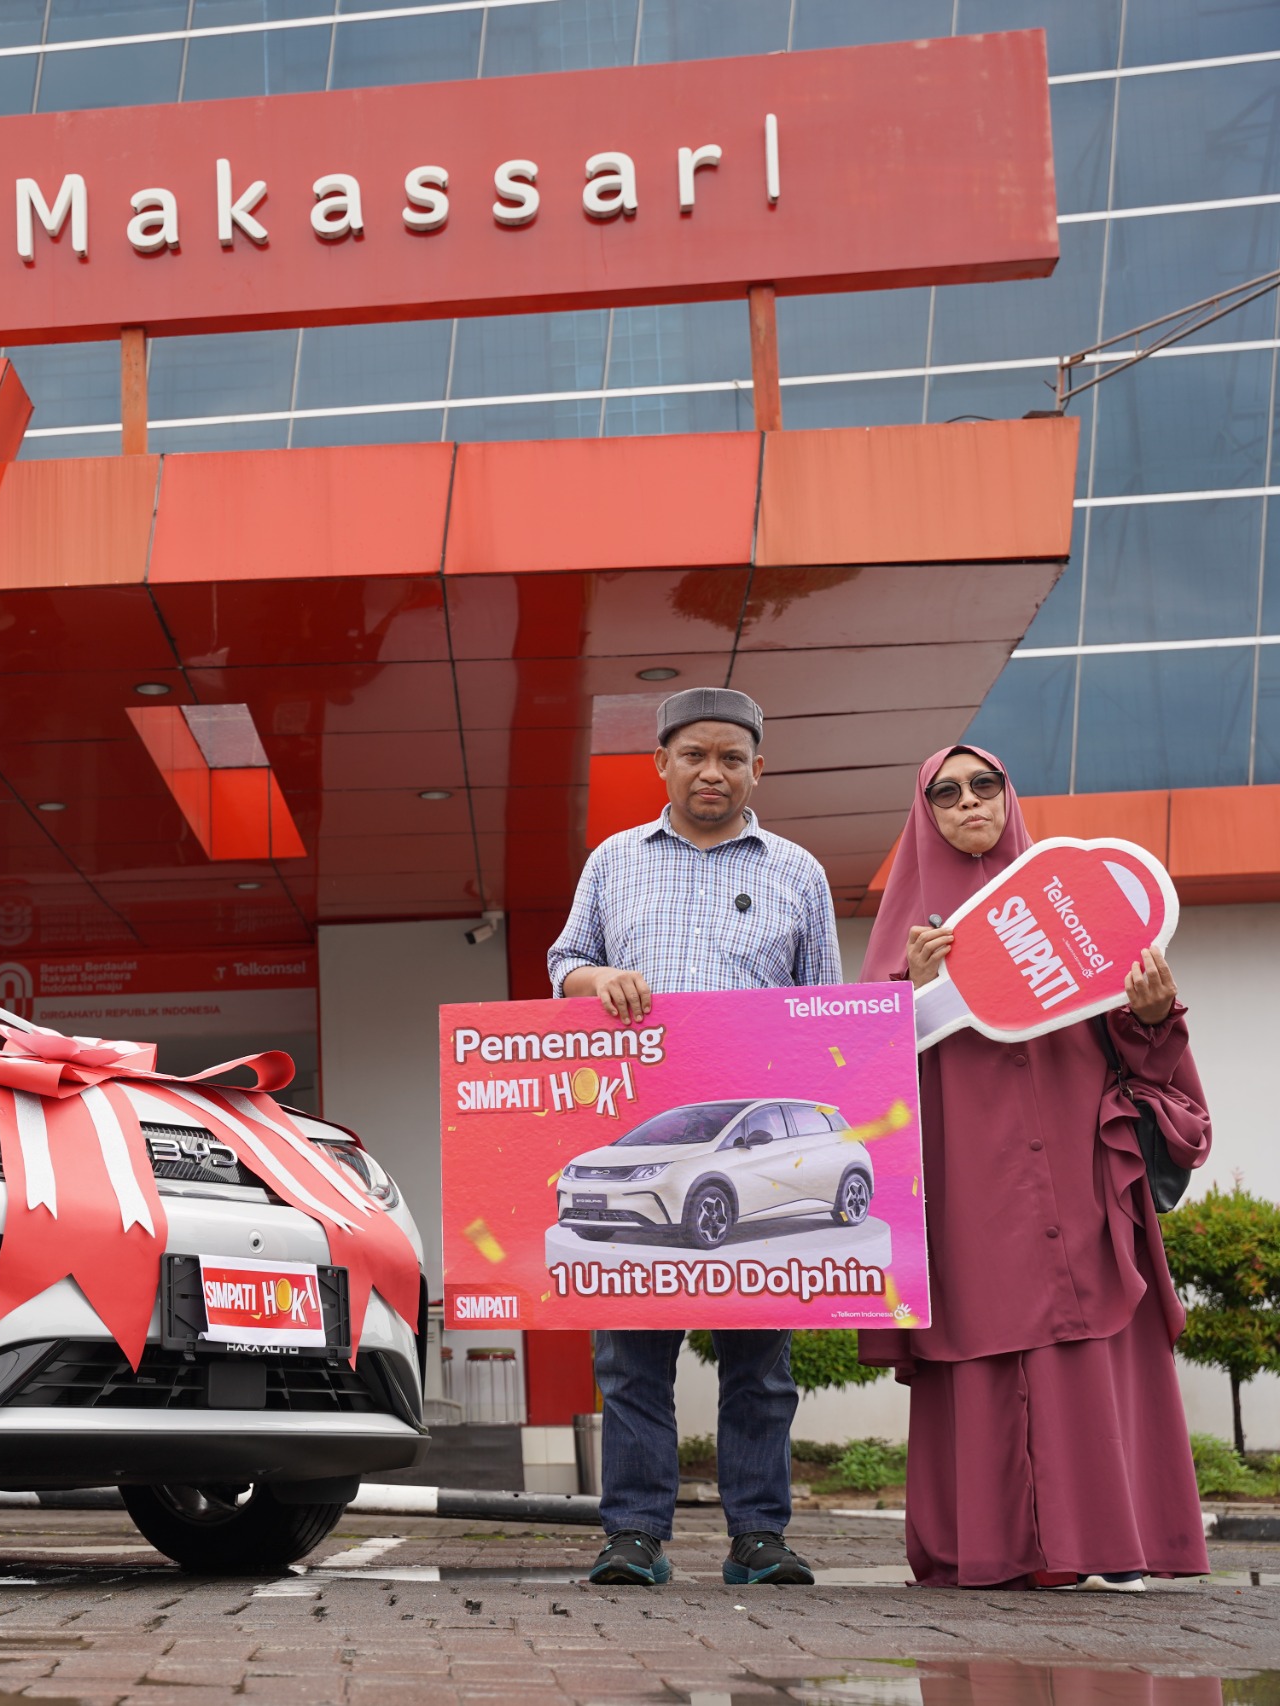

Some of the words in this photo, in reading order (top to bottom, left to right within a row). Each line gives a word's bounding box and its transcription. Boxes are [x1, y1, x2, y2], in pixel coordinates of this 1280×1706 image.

[1043, 875, 1114, 974] Telkomsel
[986, 895, 1080, 1011] SIMPATI
[39, 964, 82, 973] Bersatu
[84, 961, 137, 972] Berdaulat
[40, 972, 78, 983] Rakyat
[80, 971, 131, 982] Sejahtera
[233, 960, 307, 976] Telkomsel
[40, 983, 93, 993] Indonesia
[95, 982, 123, 993] maju
[39, 1008, 102, 1020] DIRGAHAYU
[105, 1006, 159, 1018] REPUBLIK
[162, 1005, 222, 1016] INDONESIA
[785, 992, 901, 1018] Telkomsel
[454, 1027, 665, 1064] Pemenang
[457, 1078, 540, 1111] SIMPATI
[152, 1138, 239, 1168] BYD
[552, 1265, 567, 1295] 1
[575, 1263, 648, 1294] Unit
[656, 1263, 732, 1293] BYD
[740, 1259, 882, 1300] Dolphin
[205, 1280, 257, 1312] SIMPATI
[456, 1297, 518, 1320] SIMPATI
[226, 1342, 260, 1353] HAKA
